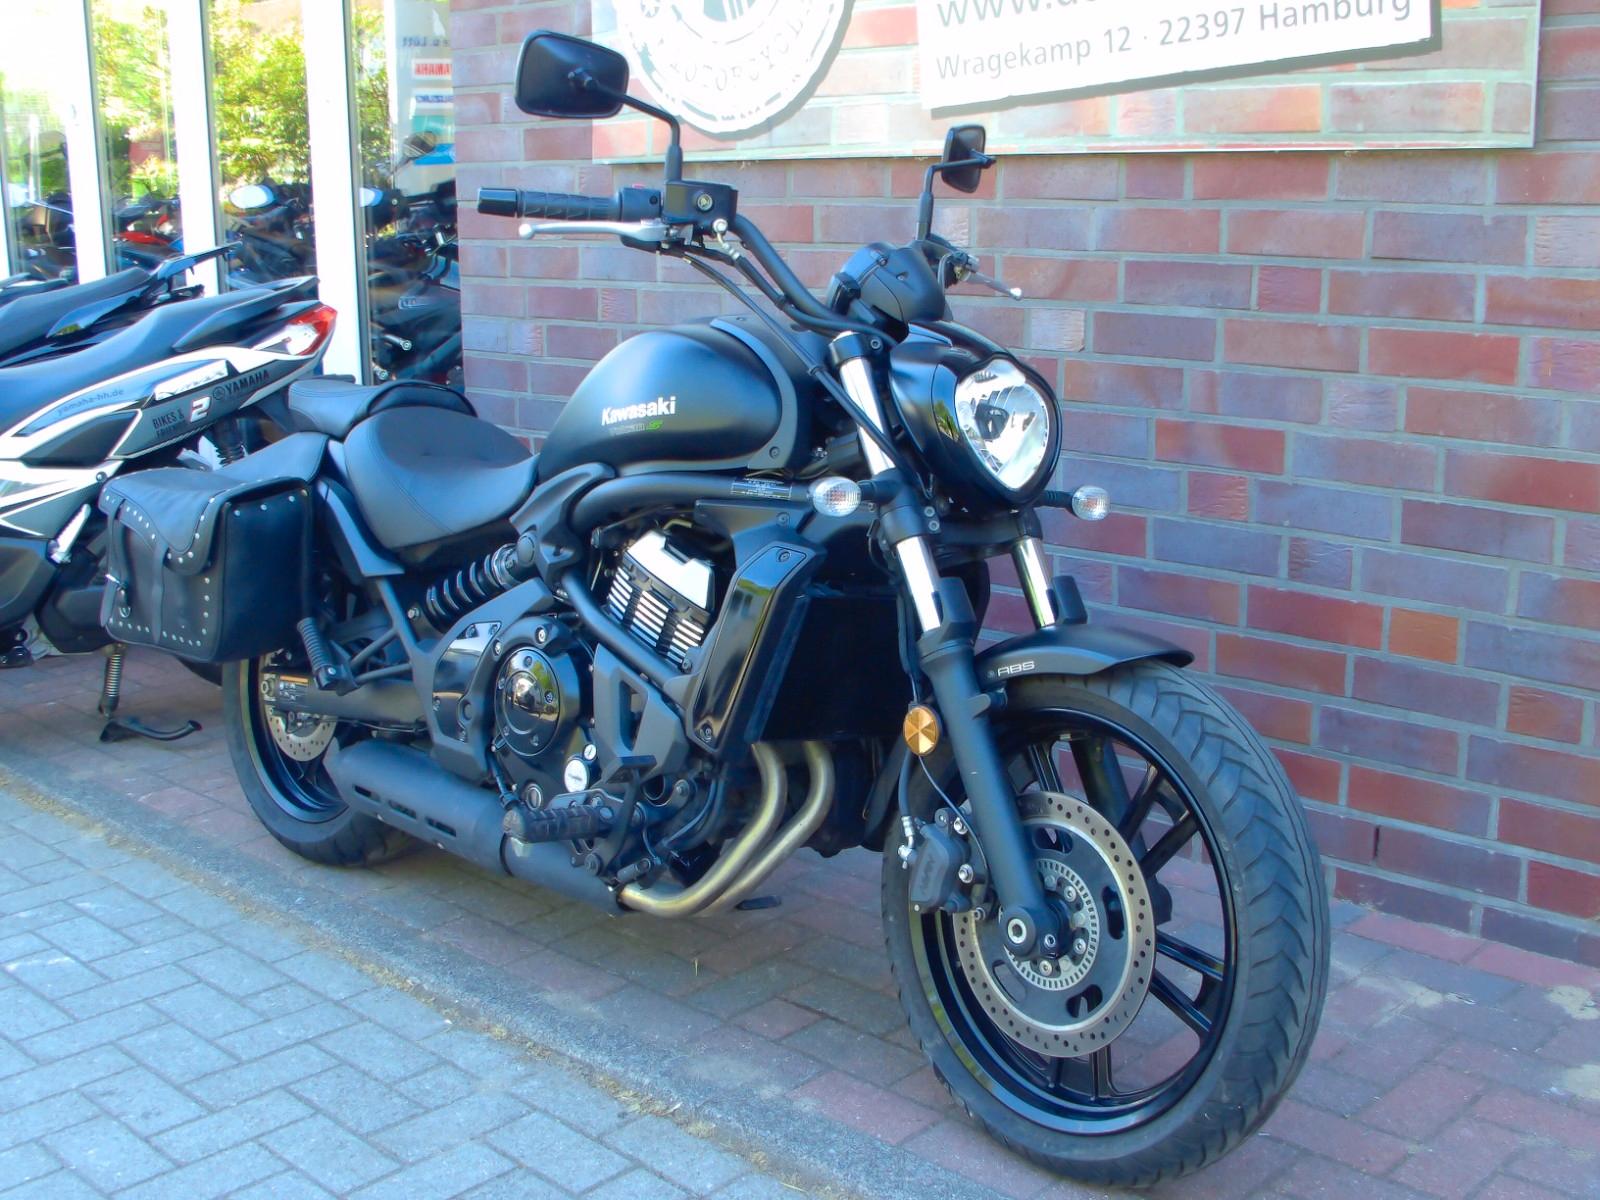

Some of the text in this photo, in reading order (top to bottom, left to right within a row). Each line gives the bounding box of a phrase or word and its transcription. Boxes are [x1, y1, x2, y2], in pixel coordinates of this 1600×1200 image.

[936, 0, 1411, 79] Wragekamp 12 22397 Hamburg
[225, 368, 270, 396] YAMAHA
[601, 395, 676, 426] Kawasaki
[997, 660, 1036, 677] ABS
